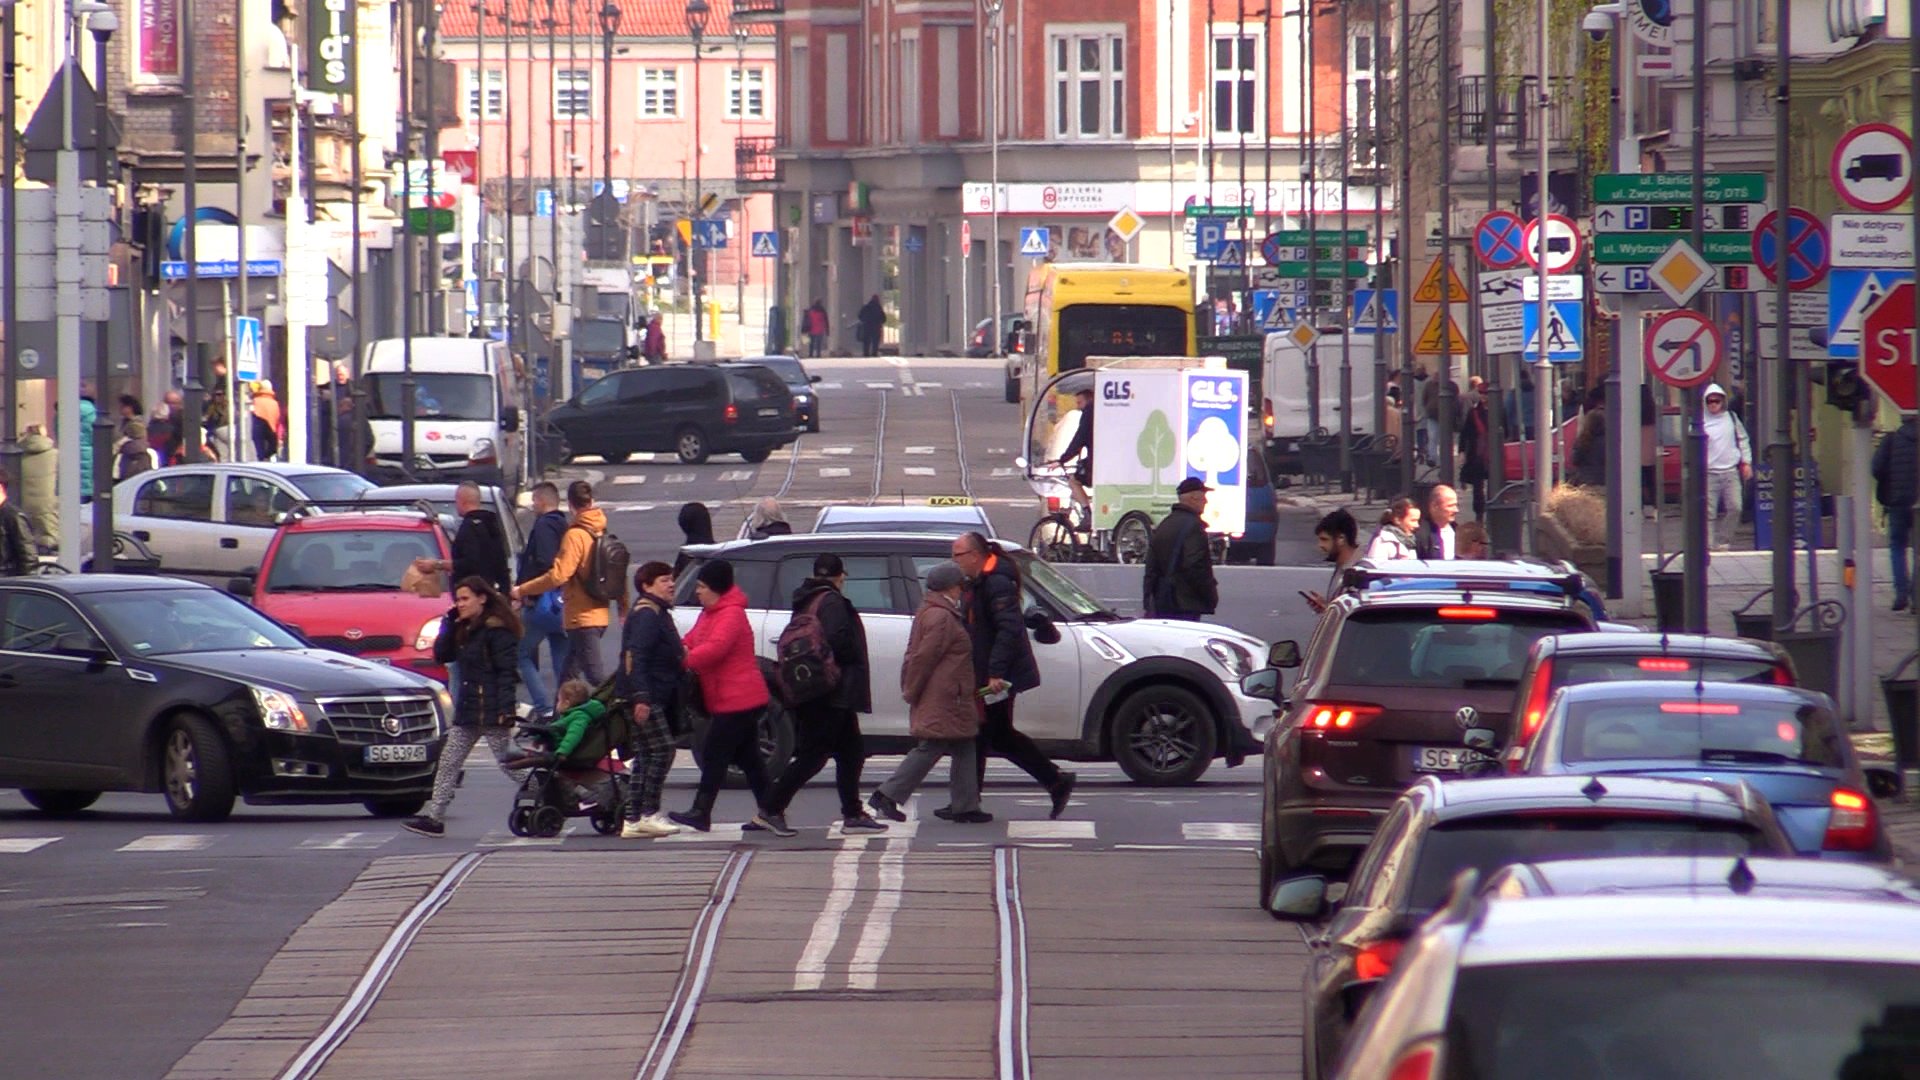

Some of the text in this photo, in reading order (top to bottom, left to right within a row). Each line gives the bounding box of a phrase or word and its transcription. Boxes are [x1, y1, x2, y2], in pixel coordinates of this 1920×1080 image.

[1842, 219, 1905, 231] Nie dotyczy
[1839, 249, 1912, 260] komunalnych
[933, 496, 967, 505] TAXI
[1426, 749, 1450, 767] SG
